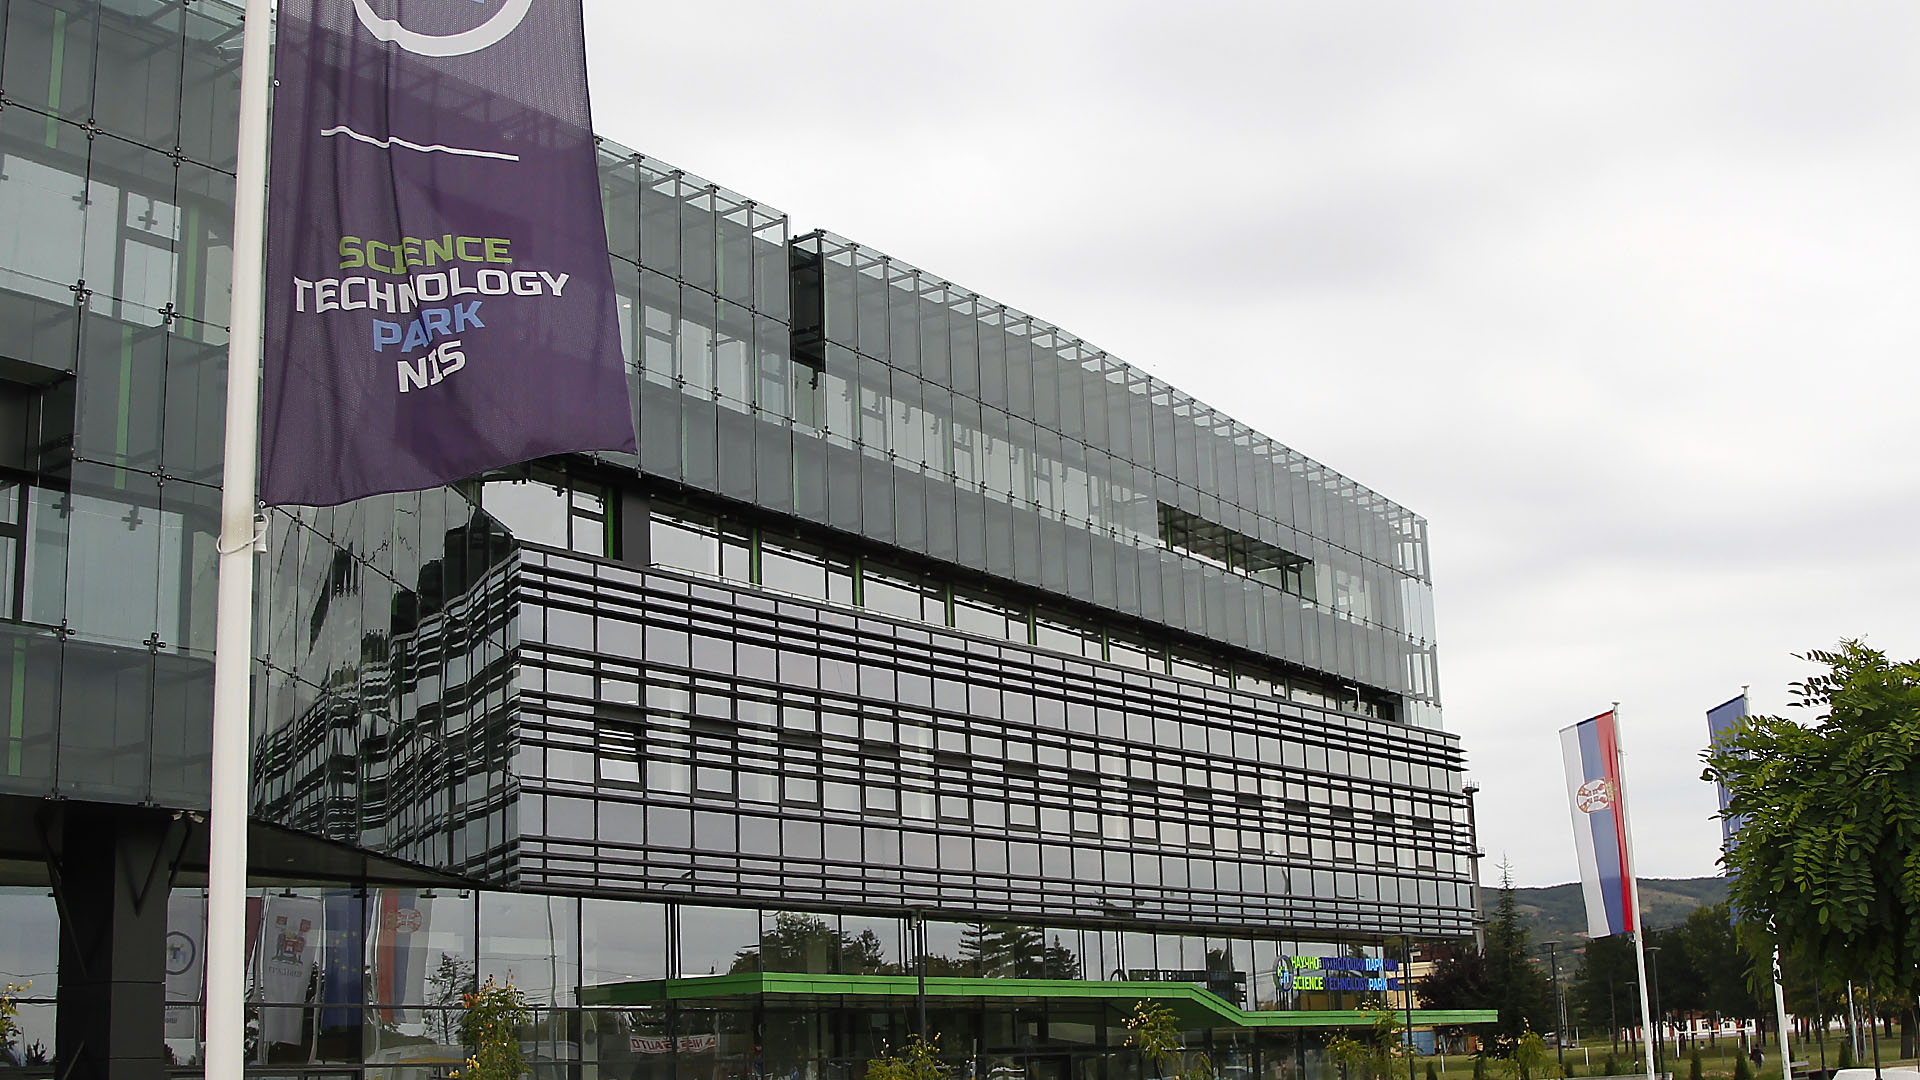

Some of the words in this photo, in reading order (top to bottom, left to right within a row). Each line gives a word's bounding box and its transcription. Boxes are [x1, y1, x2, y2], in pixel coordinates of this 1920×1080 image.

[339, 235, 512, 274] SCIENCE
[294, 267, 570, 313] TECHNOLOGY
[372, 301, 485, 353] PARK
[397, 340, 466, 393] NIS
[1291, 956, 1319, 970] НАУЧНО
[1366, 958, 1384, 972] ПАРК
[1293, 977, 1324, 991] SCIENCE
[1324, 977, 1368, 991] TECHNOLOGY
[1368, 978, 1388, 991] PARK
